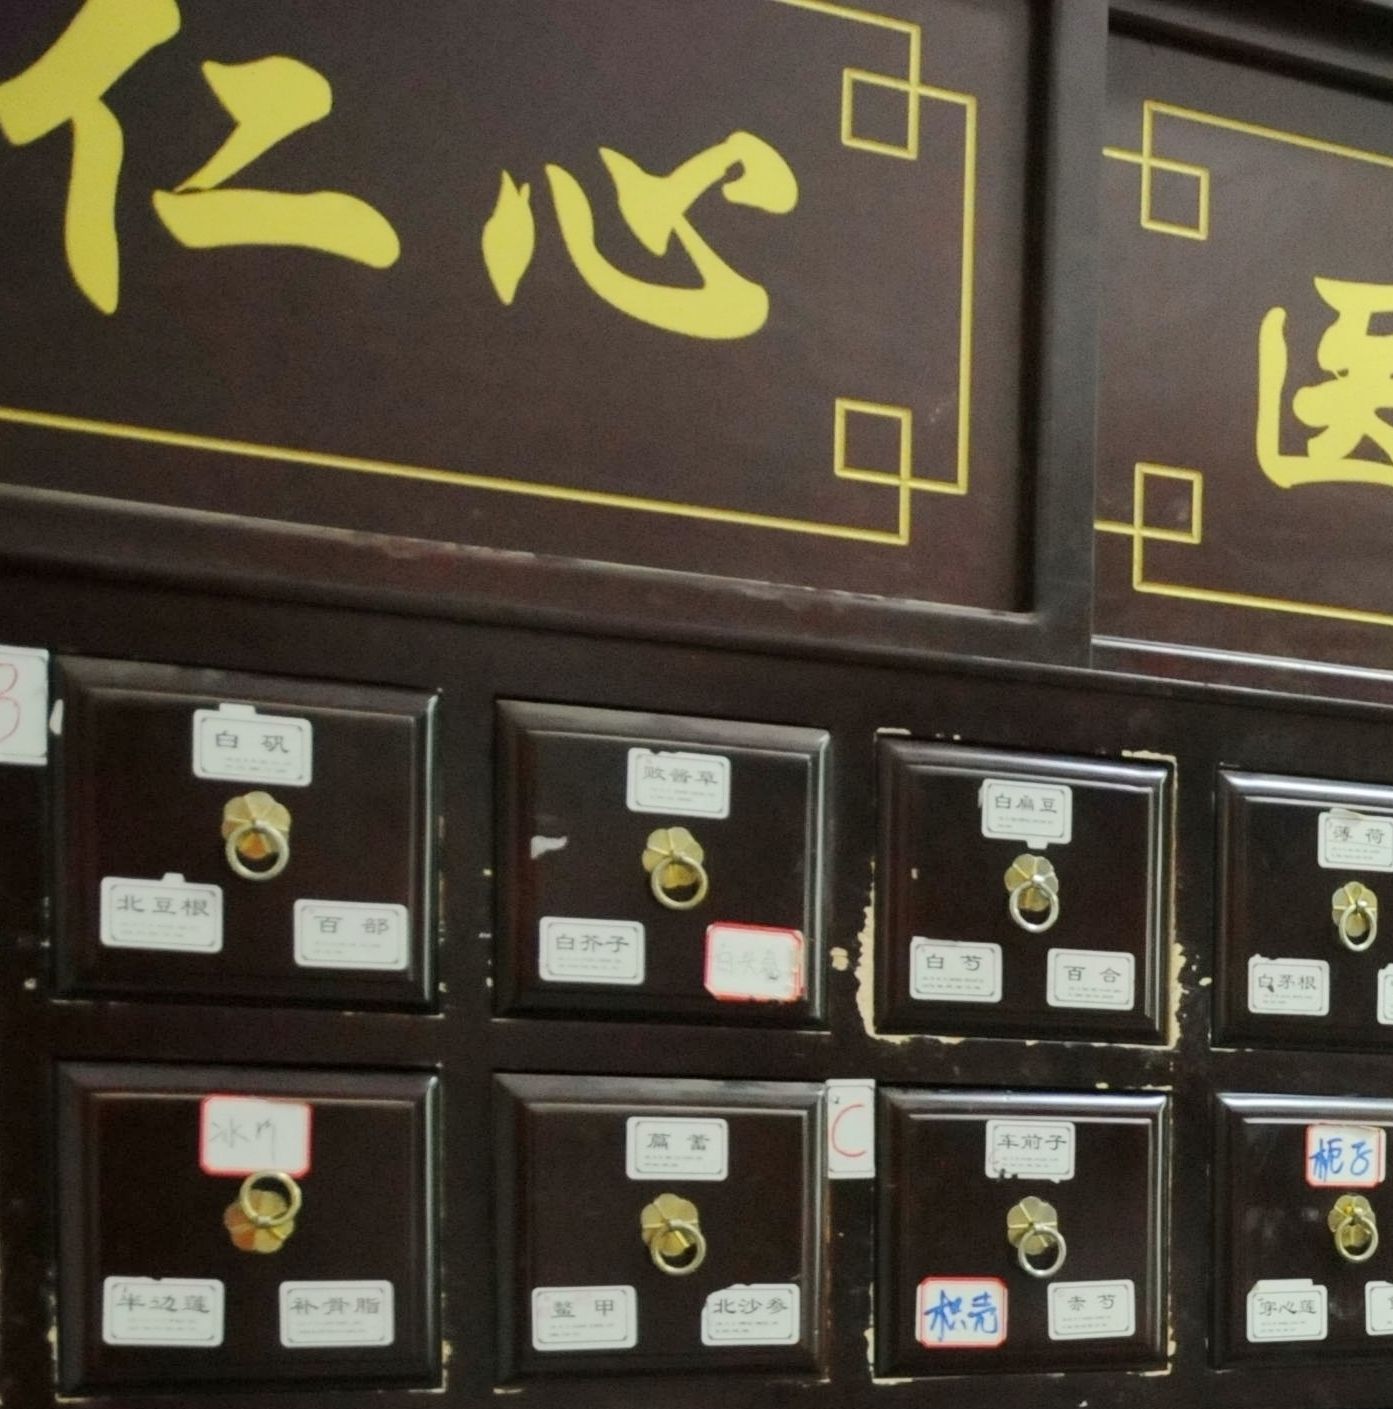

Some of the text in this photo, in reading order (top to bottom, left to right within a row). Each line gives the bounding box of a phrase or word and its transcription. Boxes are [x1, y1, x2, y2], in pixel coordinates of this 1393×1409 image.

[0, 0, 799, 340] 仁心
[213, 729, 290, 755] 白矾
[642, 764, 719, 786] 败酱草
[993, 792, 1058, 815] 白扁豆
[115, 893, 210, 917] 北豆根
[312, 914, 390, 936] 百部
[554, 932, 630, 954] 白芥子
[924, 952, 983, 972] 白芍
[1062, 964, 1122, 984] 百合
[1257, 972, 1317, 992] 白茅根
[996, 1132, 1067, 1152] 车前子
[1309, 1138, 1368, 1181] 栀子
[115, 1292, 211, 1315] 半边莲
[289, 1296, 381, 1316] 补骨脂
[711, 1296, 789, 1316] 北沙参
[1066, 1292, 1116, 1312] 赤芍
[1260, 1299, 1318, 1317] 穿心莲
